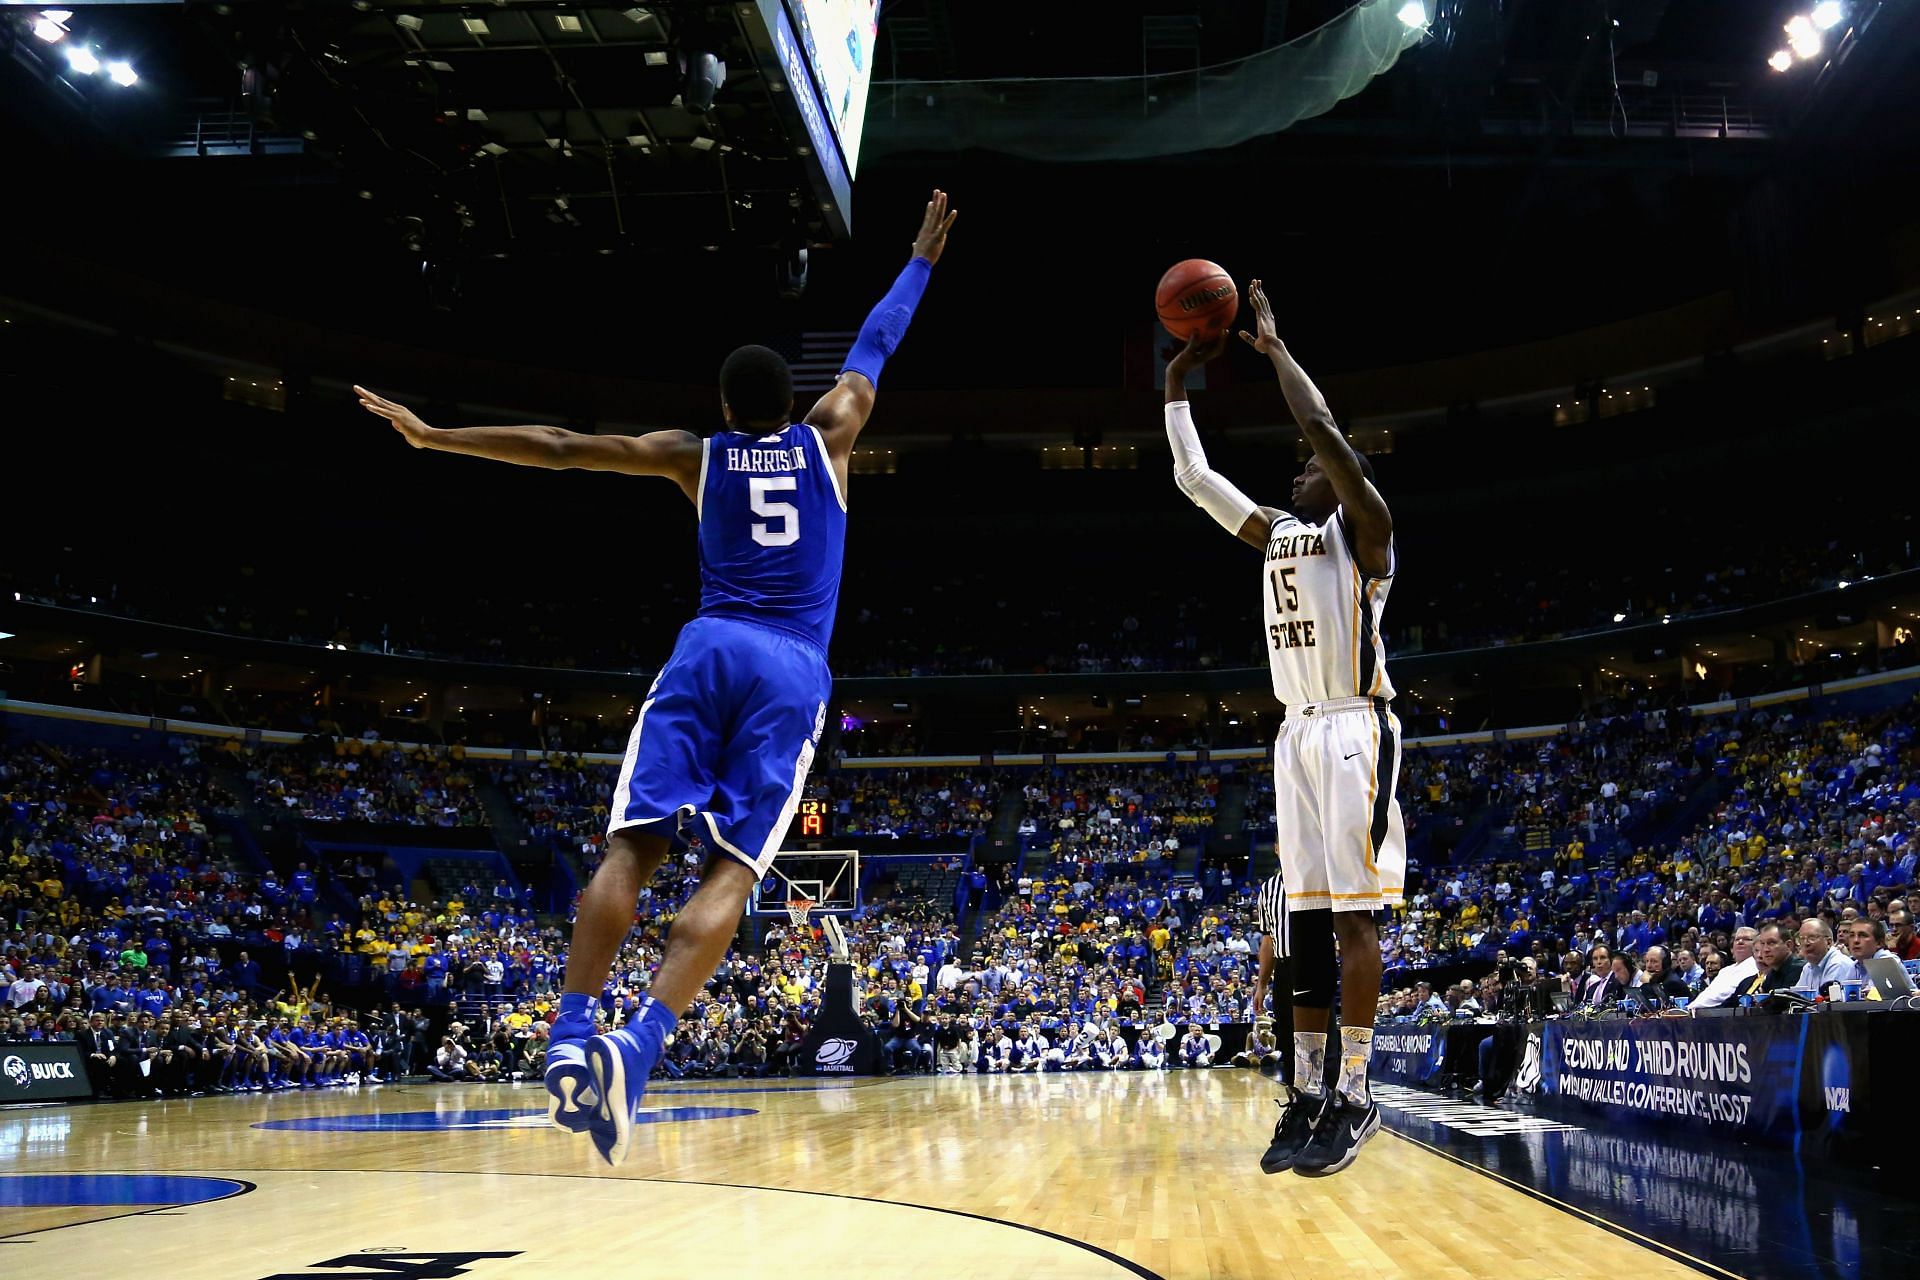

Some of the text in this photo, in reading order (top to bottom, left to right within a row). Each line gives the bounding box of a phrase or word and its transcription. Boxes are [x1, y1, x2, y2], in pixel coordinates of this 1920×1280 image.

[727, 446, 807, 472] HARRISON
[749, 476, 801, 547] 5
[1266, 533, 1327, 562] ICHITA
[1270, 567, 1299, 614] 15
[1270, 620, 1316, 650] STATE
[803, 815, 820, 835] 19
[31, 1062, 75, 1080] BUICK
[1606, 1039, 1630, 1072] AND
[1635, 1040, 1676, 1075] THIRD
[1678, 1041, 1752, 1084] ROUNDS
[1710, 1095, 1752, 1125] HOST
[1824, 1086, 1851, 1113] NCAA
